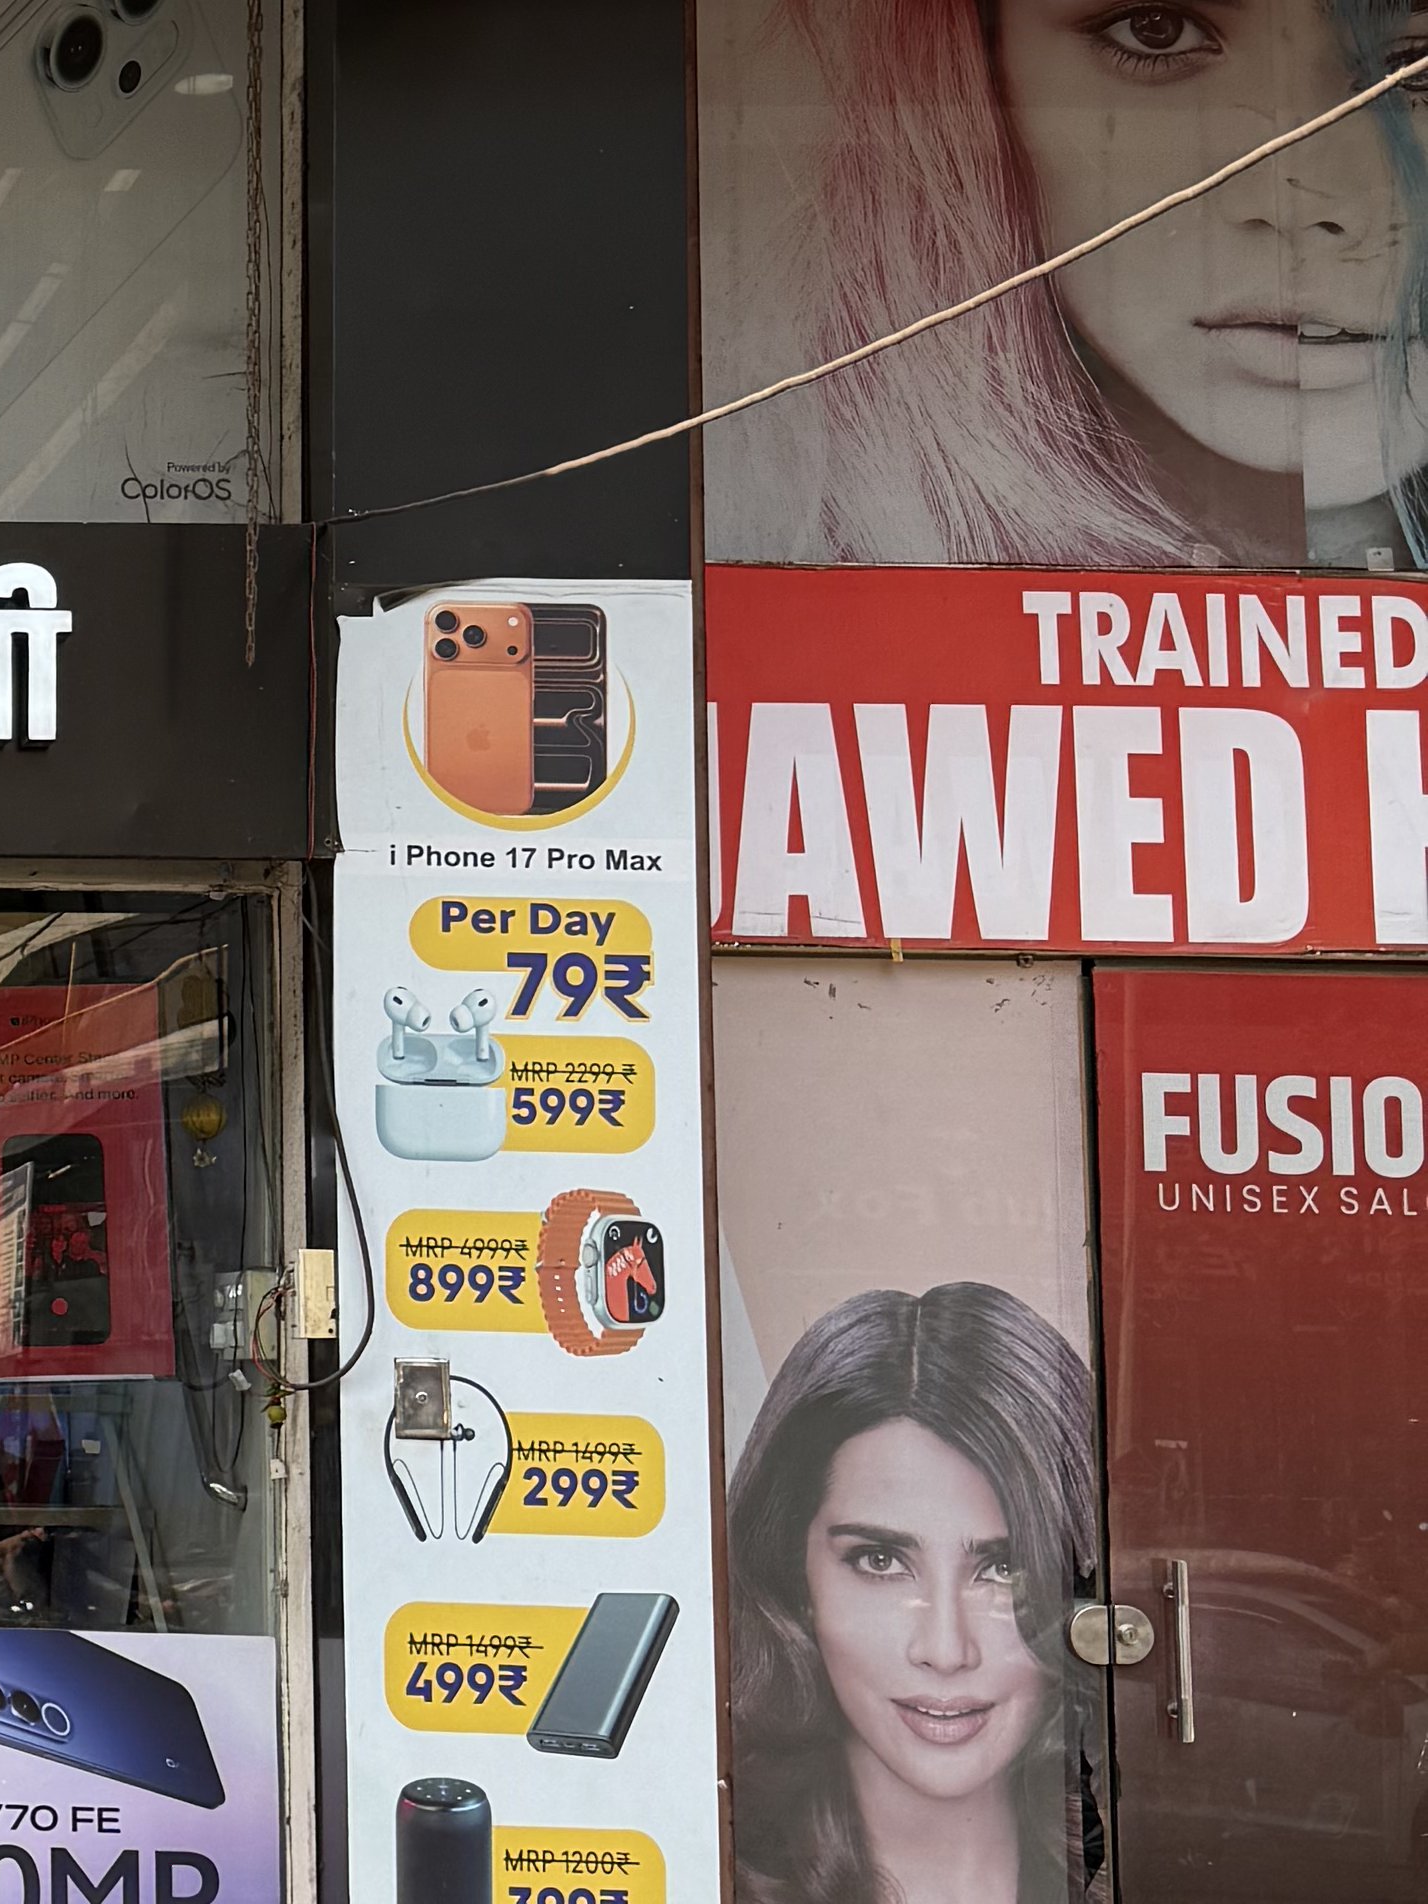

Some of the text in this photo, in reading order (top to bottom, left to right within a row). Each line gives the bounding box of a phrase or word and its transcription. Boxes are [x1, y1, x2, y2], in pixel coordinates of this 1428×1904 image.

[166, 461, 231, 477] Powered by
[121, 476, 232, 503] ColorOS
[1022, 591, 1428, 689] TRAINED
[707, 702, 1310, 944] AWED
[407, 845, 496, 870] Phone
[506, 847, 537, 870] 17
[548, 848, 596, 871] Pro
[606, 849, 662, 873] Max
[441, 900, 616, 946] Per Day
[506, 951, 654, 1022] 79₹
[512, 1088, 625, 1127] 599₹
[1142, 1072, 1426, 1178] FUSIO
[1158, 1183, 1428, 1216] UNISEX SAL
[408, 1263, 526, 1305] 899₹
[71, 1807, 121, 1834] FE
